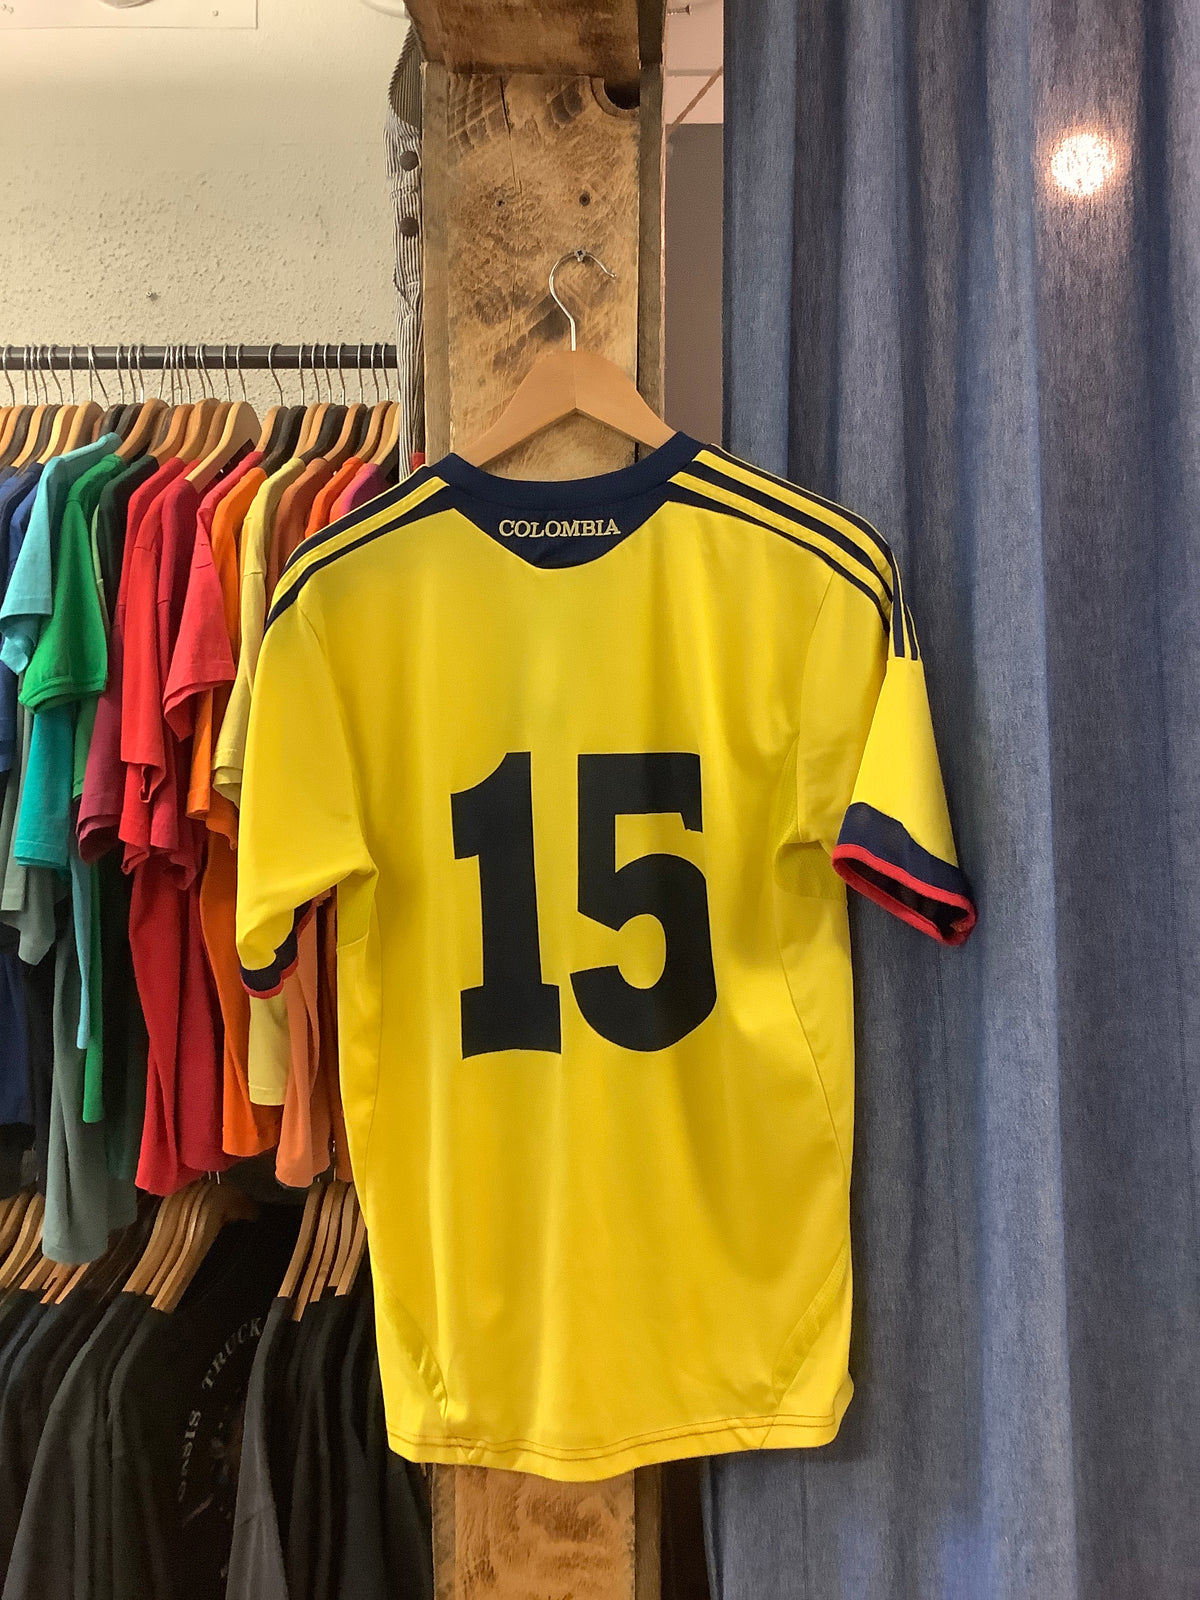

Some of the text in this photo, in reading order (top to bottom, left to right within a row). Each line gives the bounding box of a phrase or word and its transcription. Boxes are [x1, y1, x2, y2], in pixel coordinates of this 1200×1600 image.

[499, 518, 622, 538] COLOMBIA
[450, 751, 717, 1060] 15
[201, 1317, 263, 1391] TRUCK
